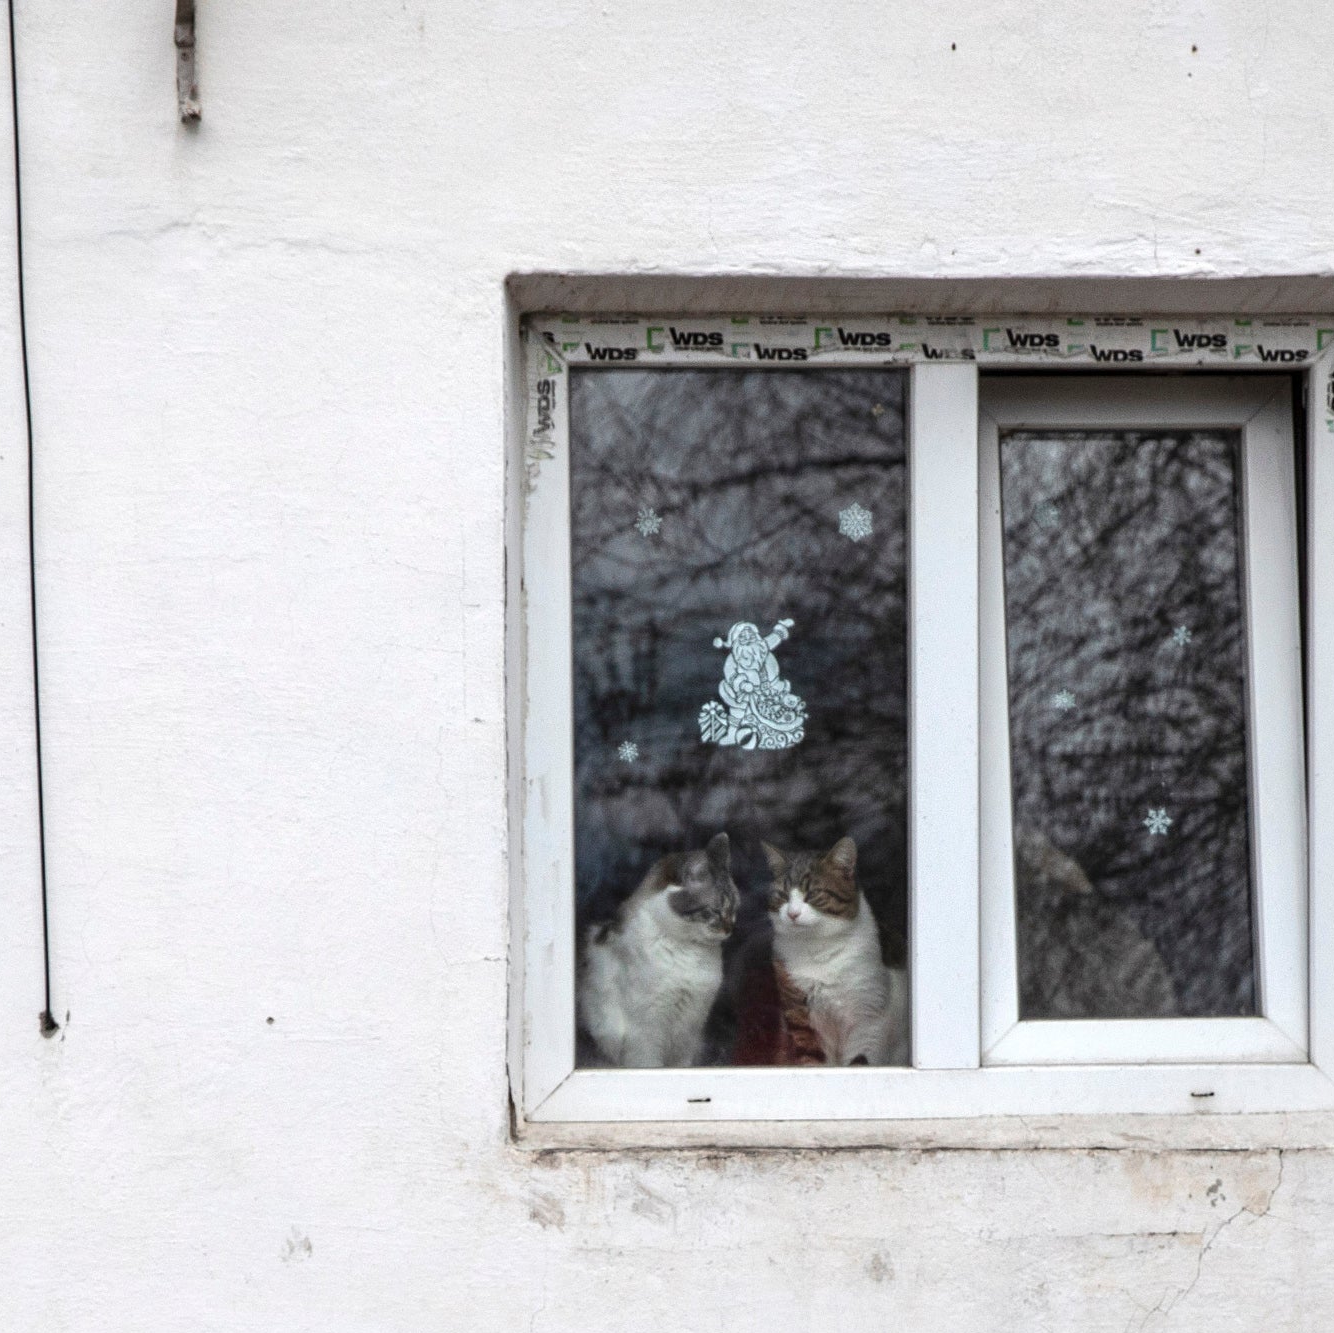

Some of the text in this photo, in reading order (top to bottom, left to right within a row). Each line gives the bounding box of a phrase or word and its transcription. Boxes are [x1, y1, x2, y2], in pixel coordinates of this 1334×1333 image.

[669, 327, 1227, 348] WDS WDS WDS WDS
[585, 342, 637, 361] WDS
[753, 343, 807, 361] WDS
[1089, 344, 1144, 362] WDS
[1257, 344, 1309, 362] WDS
[532, 379, 551, 434] WDS
